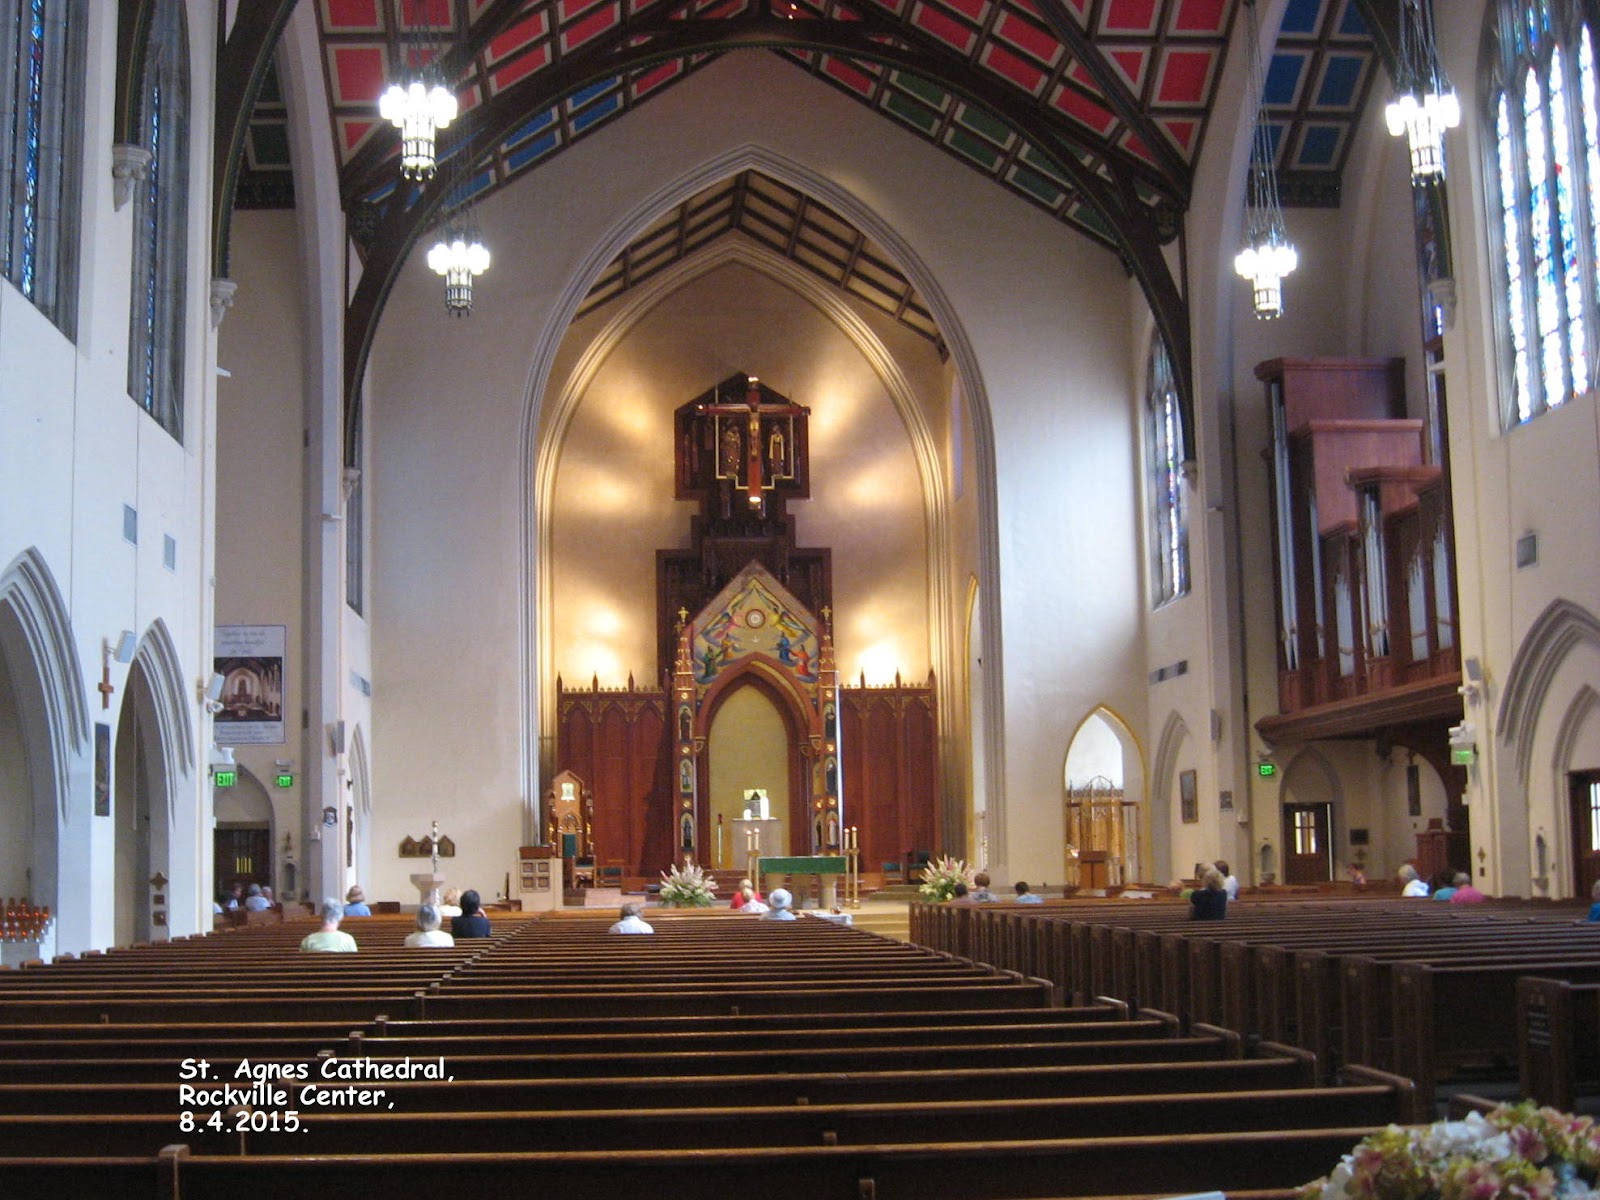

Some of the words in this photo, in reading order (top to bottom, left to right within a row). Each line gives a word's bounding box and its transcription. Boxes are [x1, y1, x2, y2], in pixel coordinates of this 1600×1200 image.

[1260, 765, 1273, 775] EXIT
[216, 772, 234, 786] EXIT
[278, 776, 291, 787] EXIT
